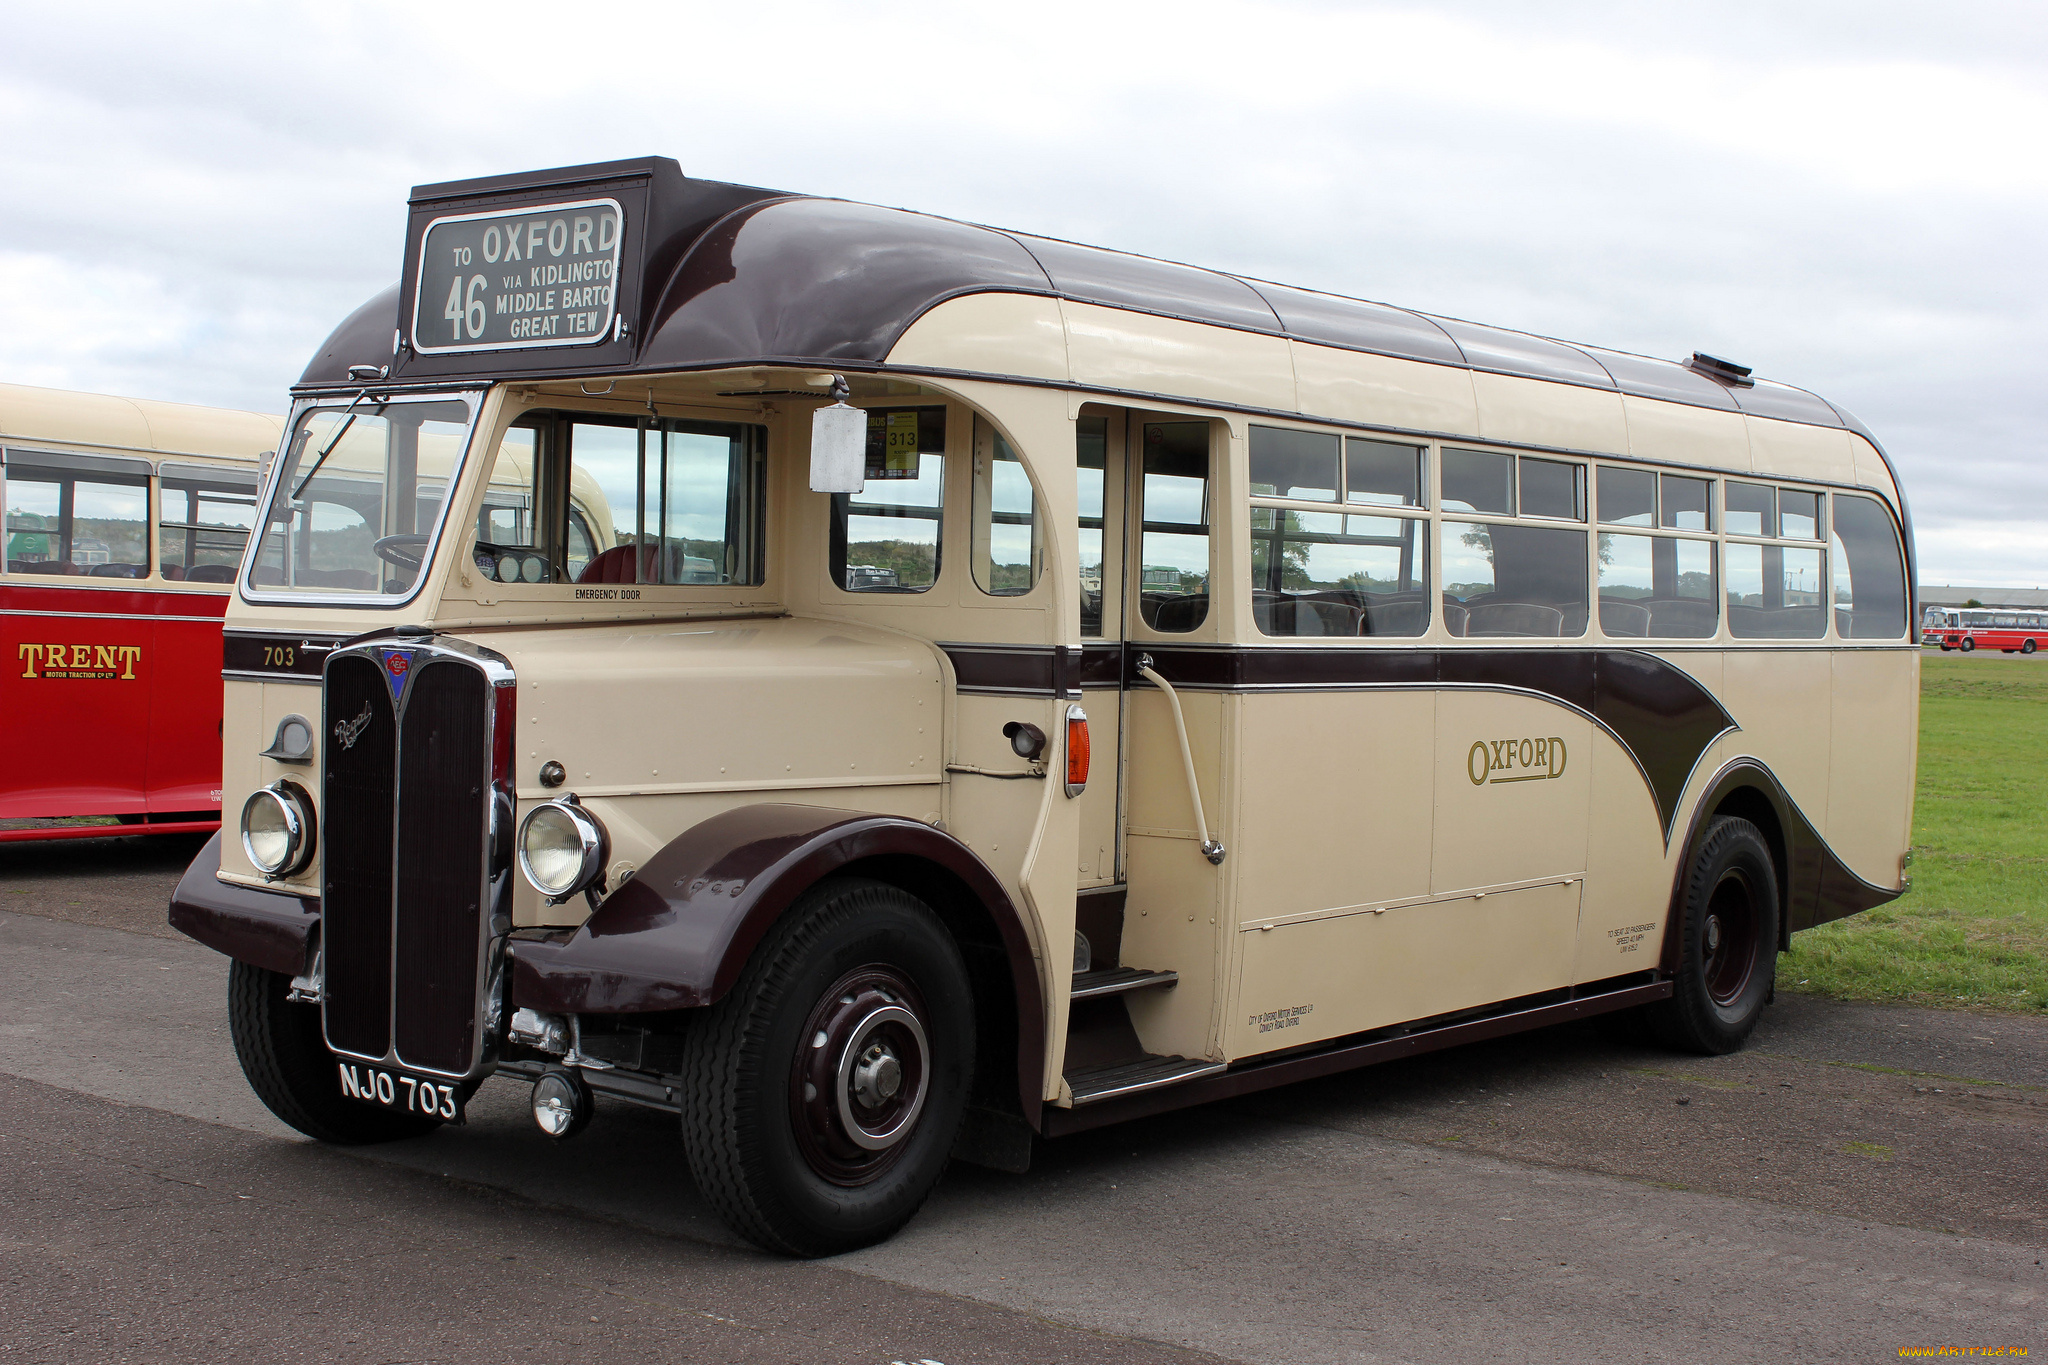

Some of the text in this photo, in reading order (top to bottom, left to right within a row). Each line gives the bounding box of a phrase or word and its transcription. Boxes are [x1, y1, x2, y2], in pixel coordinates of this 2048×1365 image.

[453, 213, 617, 267] TO OXFORD
[503, 274, 522, 289] VIA
[444, 273, 488, 341] 46
[496, 290, 555, 315] MIDDLE
[510, 311, 598, 338] GREAT TEW
[889, 431, 916, 446] 313
[575, 589, 641, 600] EMERGENCY DOOR
[18, 643, 141, 681] TRENT
[264, 646, 294, 667] 703
[390, 659, 406, 669] AEC
[1467, 736, 1568, 786] OXFORD
[1249, 1015, 1257, 1025] CITY
[1258, 1014, 1263, 1023] OF
[1263, 1011, 1277, 1022] OXFORD
[1278, 1009, 1290, 1019] MOTOR
[1291, 1006, 1307, 1016] SERVICES
[1259, 1022, 1274, 1033] COWLEY
[1285, 1017, 1299, 1027] OXFORD
[339, 1062, 457, 1120] NJO 703
